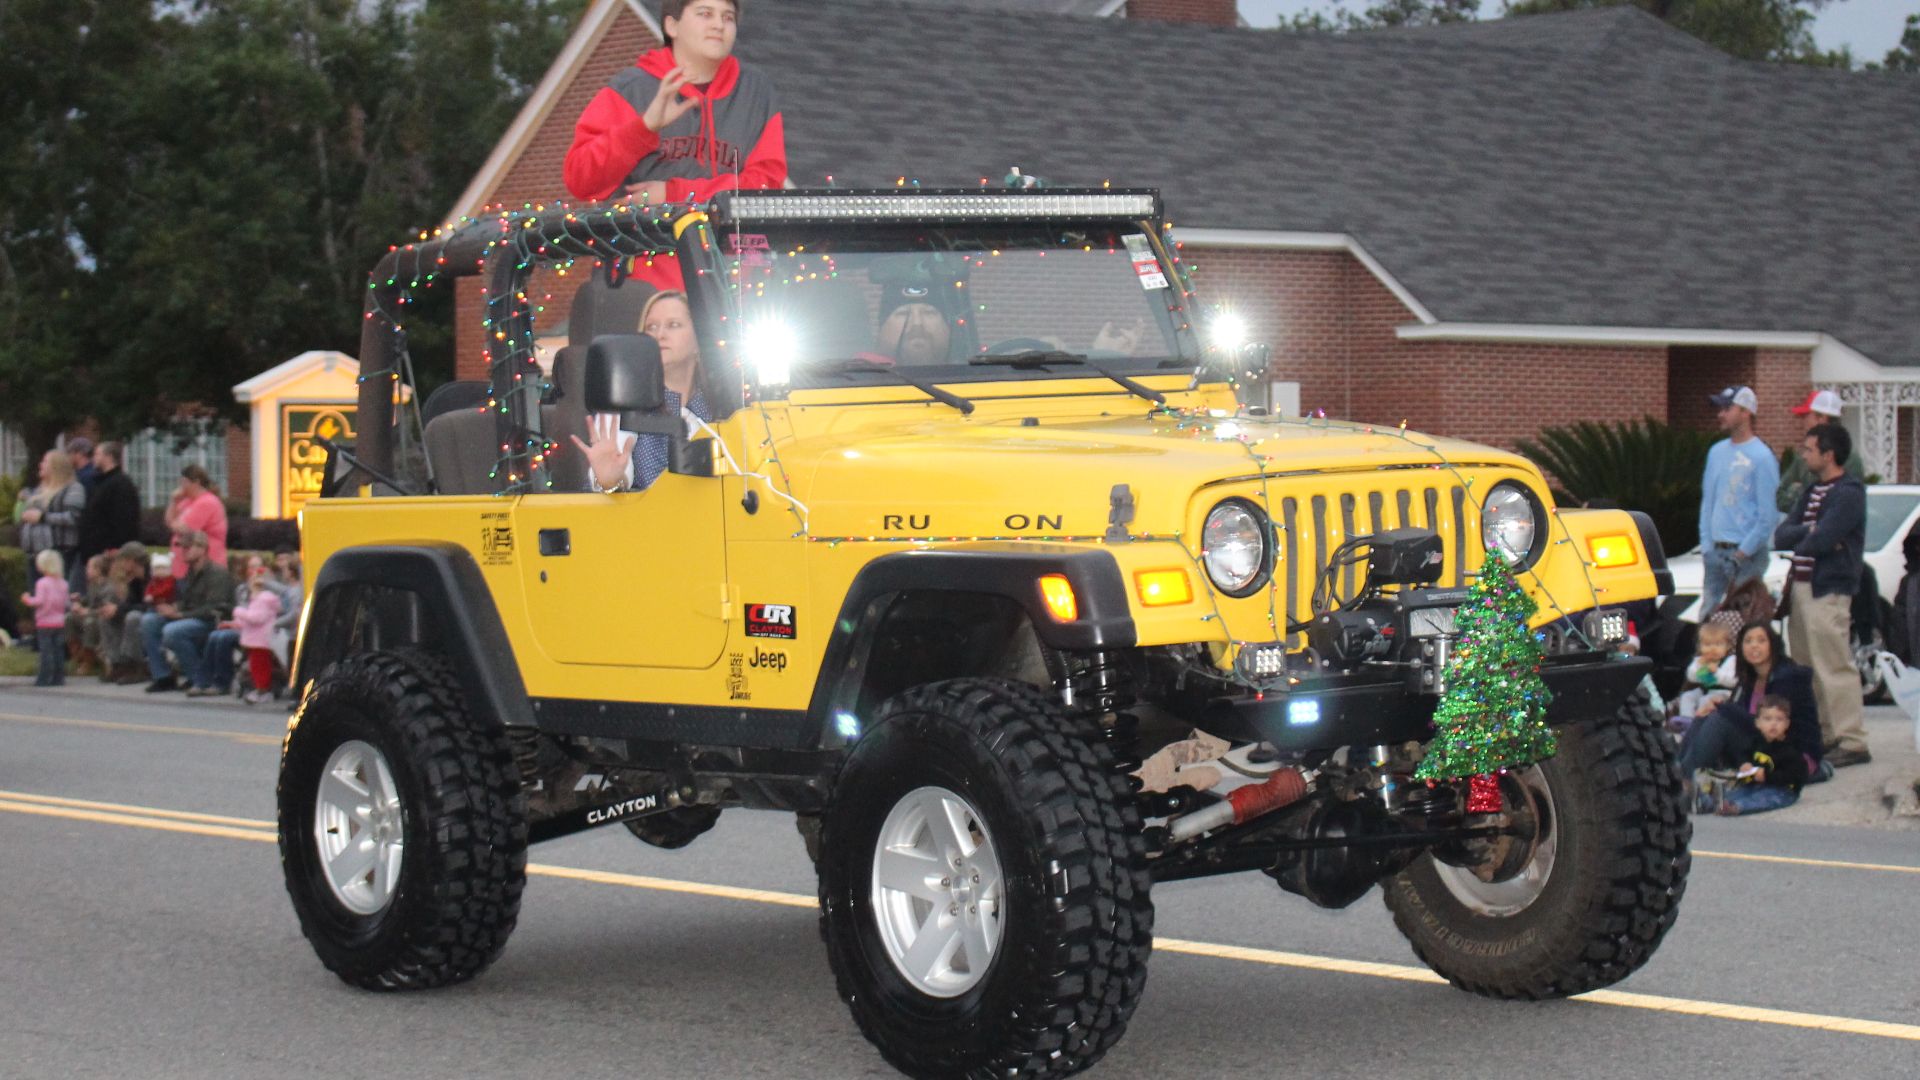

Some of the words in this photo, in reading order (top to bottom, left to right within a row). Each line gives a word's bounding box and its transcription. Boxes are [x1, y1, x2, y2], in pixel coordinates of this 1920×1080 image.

[883, 514, 931, 530] RU
[1004, 513, 1063, 530] ON
[749, 624, 793, 635] CLAYTON
[749, 646, 787, 673] Jeep
[586, 795, 657, 824] CLAYTON
